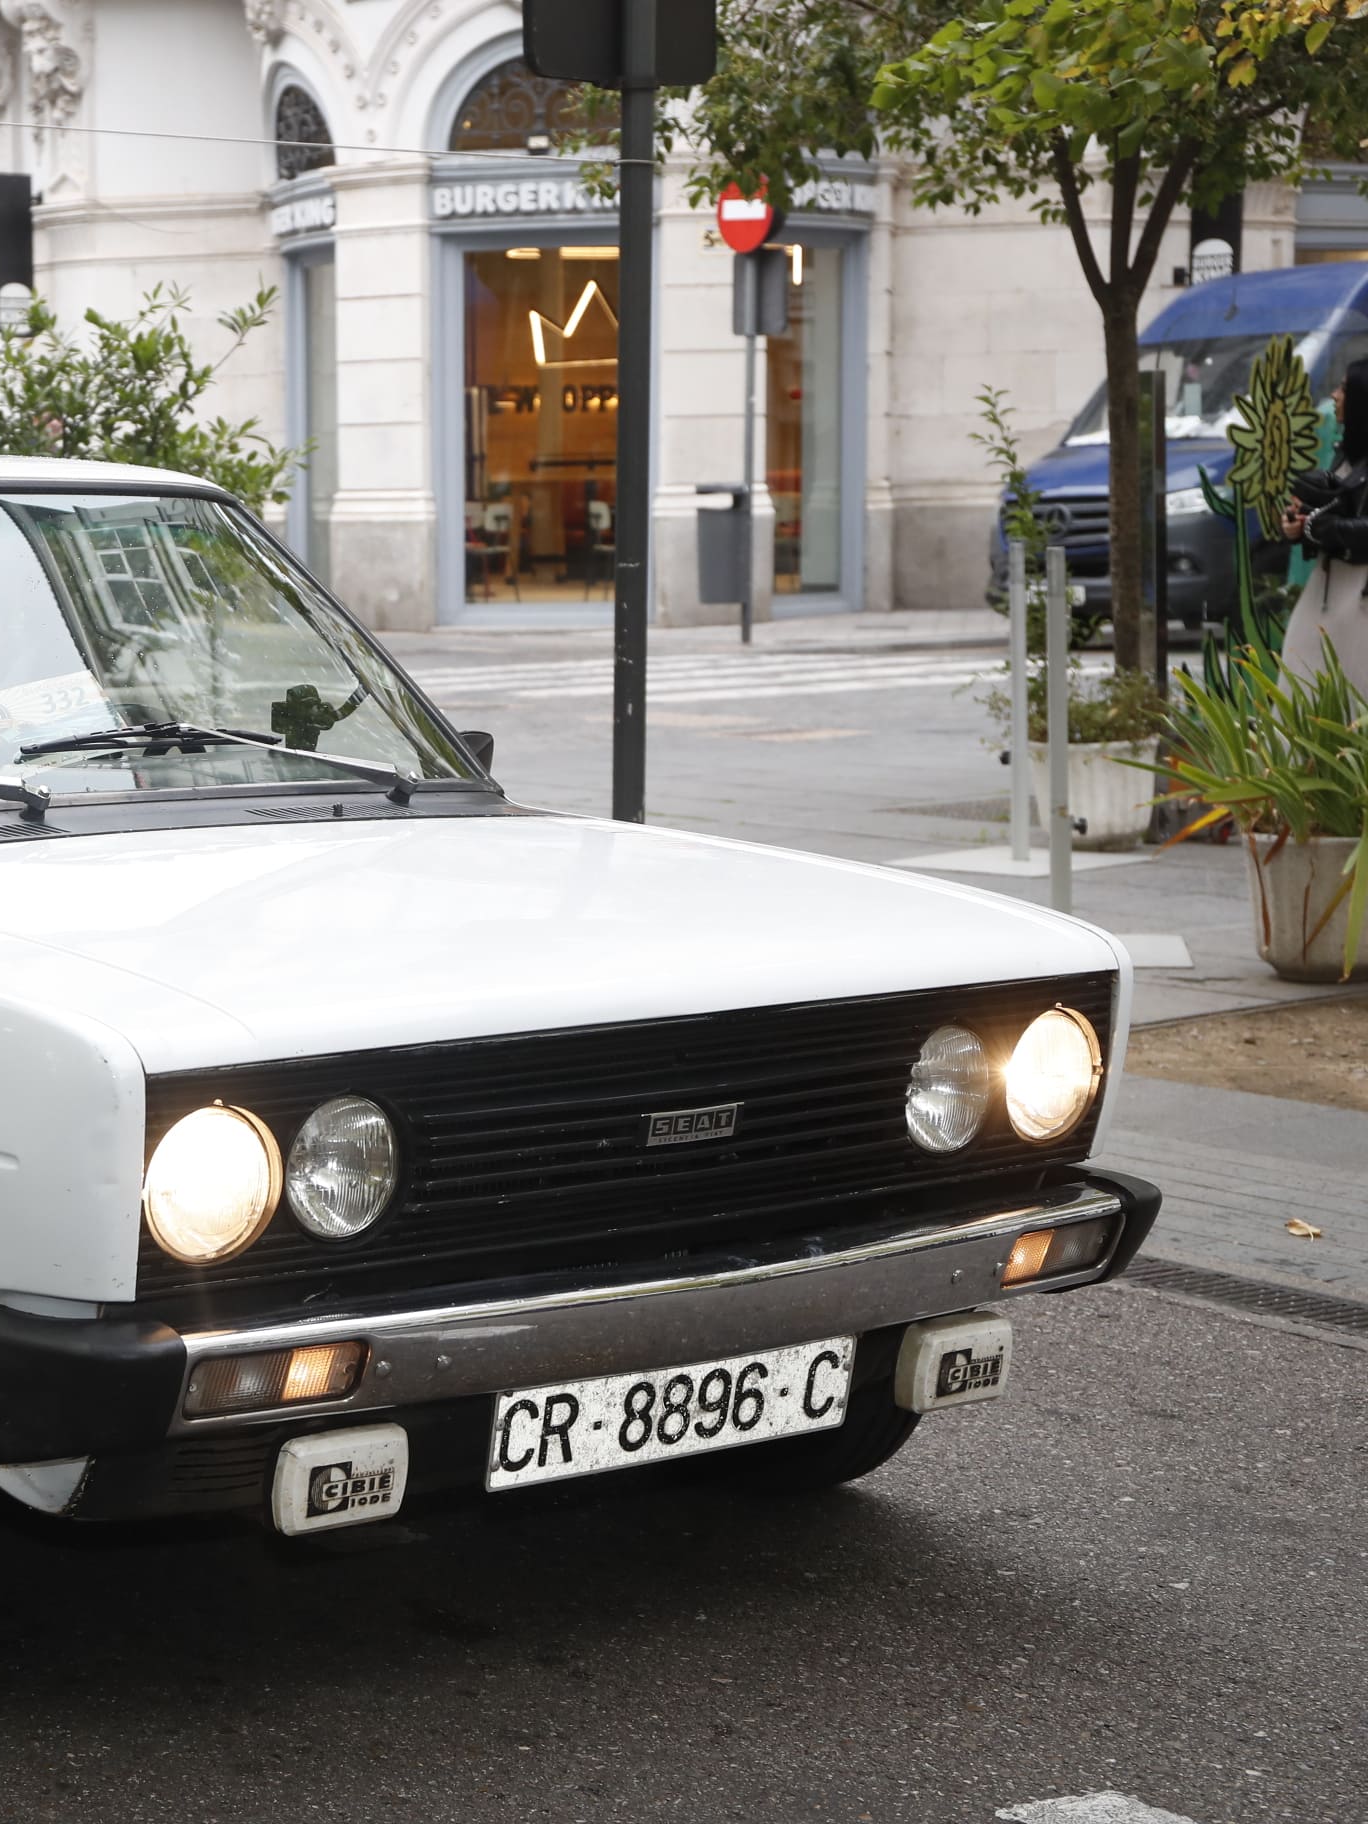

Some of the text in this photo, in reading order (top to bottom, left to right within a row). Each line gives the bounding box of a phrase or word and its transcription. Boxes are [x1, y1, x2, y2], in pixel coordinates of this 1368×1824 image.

[433, 181, 560, 217] BURGER
[40, 687, 90, 714] 332
[655, 1112, 731, 1134] SEAT
[350, 1492, 391, 1508] IODE
